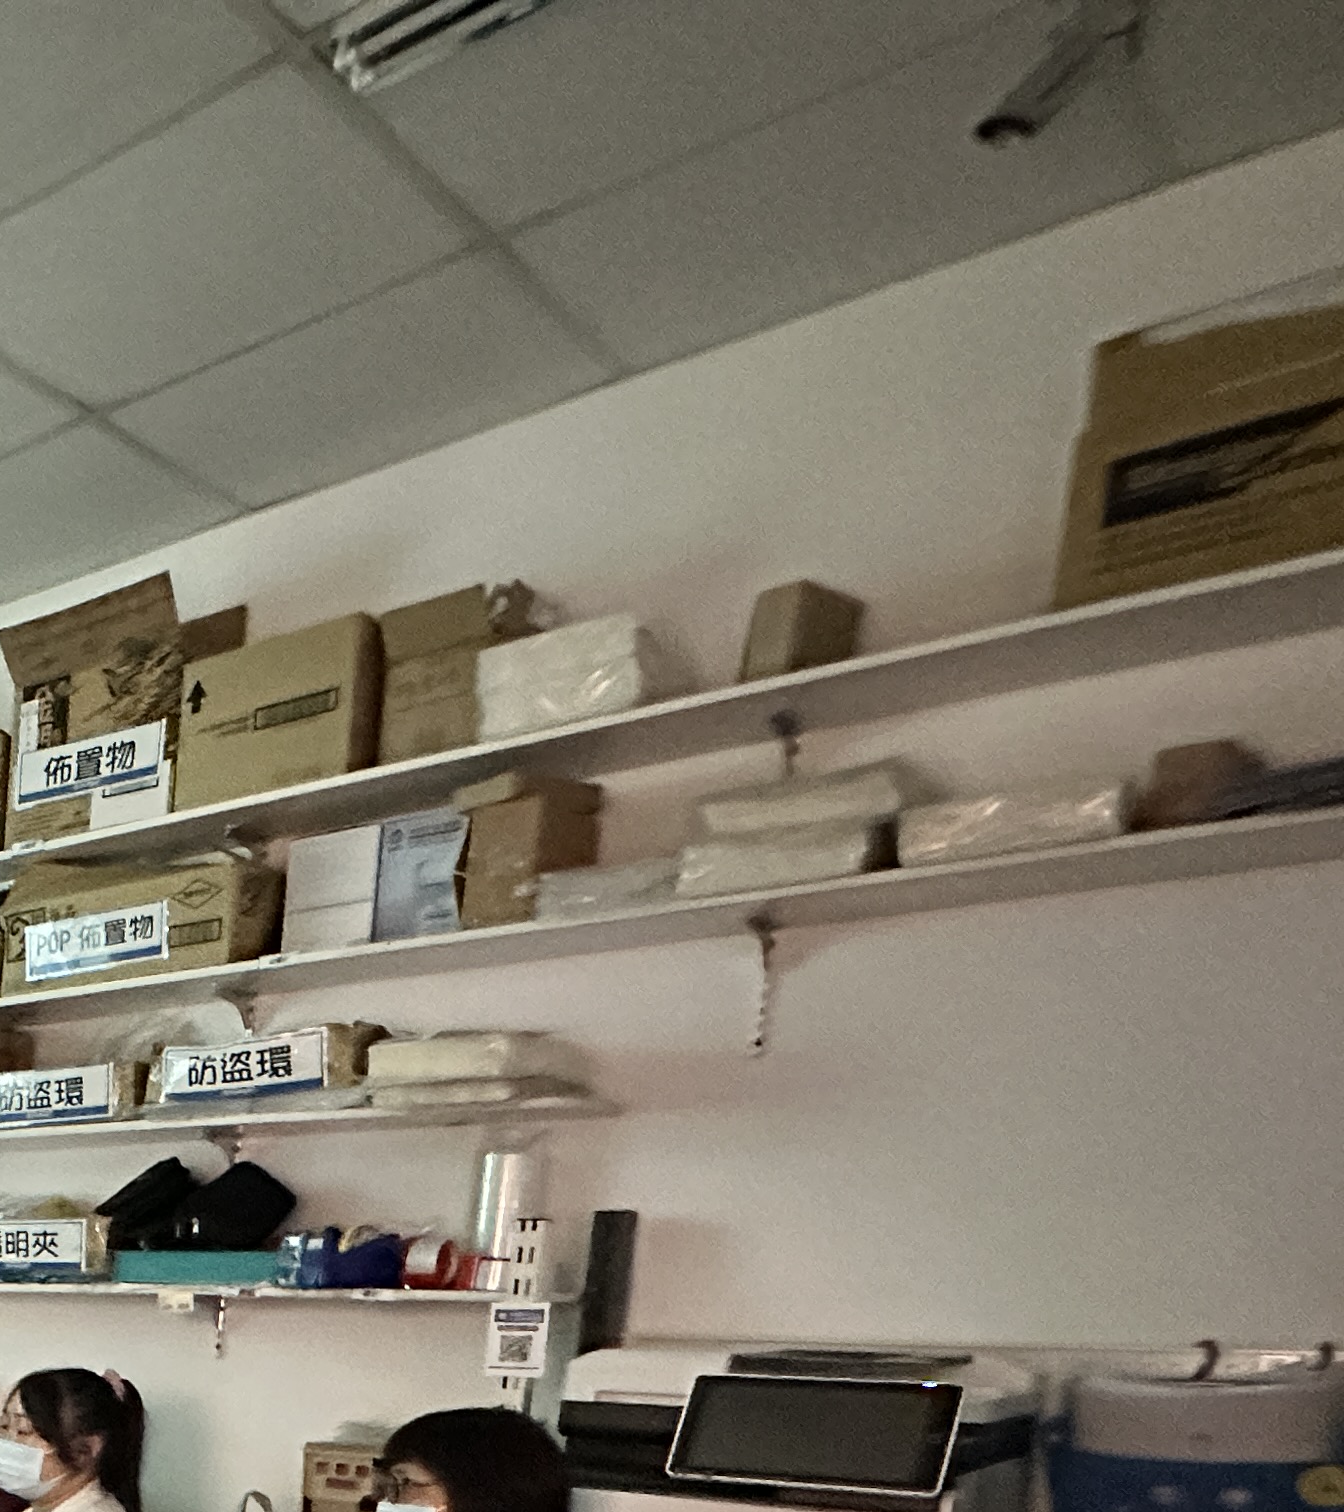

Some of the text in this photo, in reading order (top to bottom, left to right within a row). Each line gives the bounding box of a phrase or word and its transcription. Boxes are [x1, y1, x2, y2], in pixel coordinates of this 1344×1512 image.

[43, 738, 137, 787] 佈置物
[35, 928, 72, 957] POP
[79, 914, 155, 951] 佈置物
[187, 1045, 293, 1088] 防盜環
